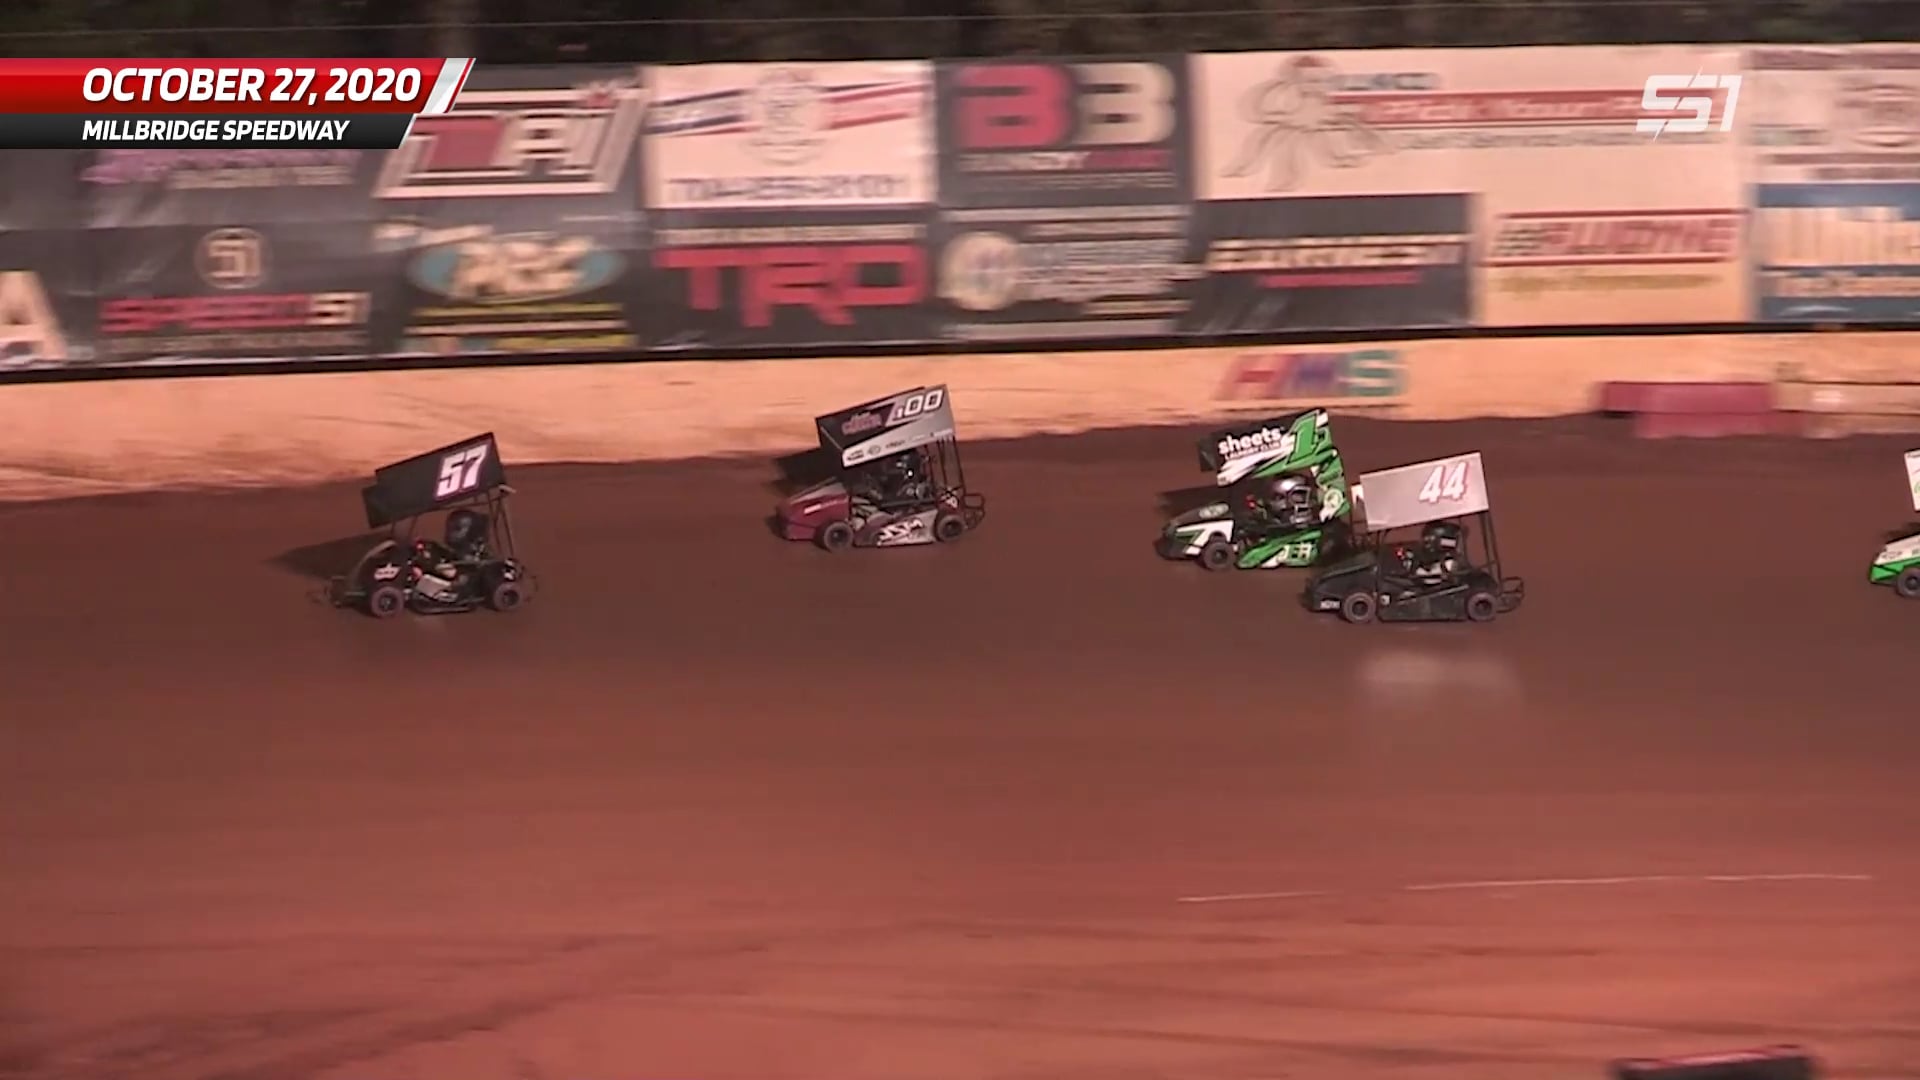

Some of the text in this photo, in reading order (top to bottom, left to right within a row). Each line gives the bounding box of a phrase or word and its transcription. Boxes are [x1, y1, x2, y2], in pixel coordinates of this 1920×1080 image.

[656, 244, 928, 327] TRD
[1218, 427, 1281, 456] sheets
[437, 444, 488, 498] 57
[1419, 461, 1468, 504] 44
